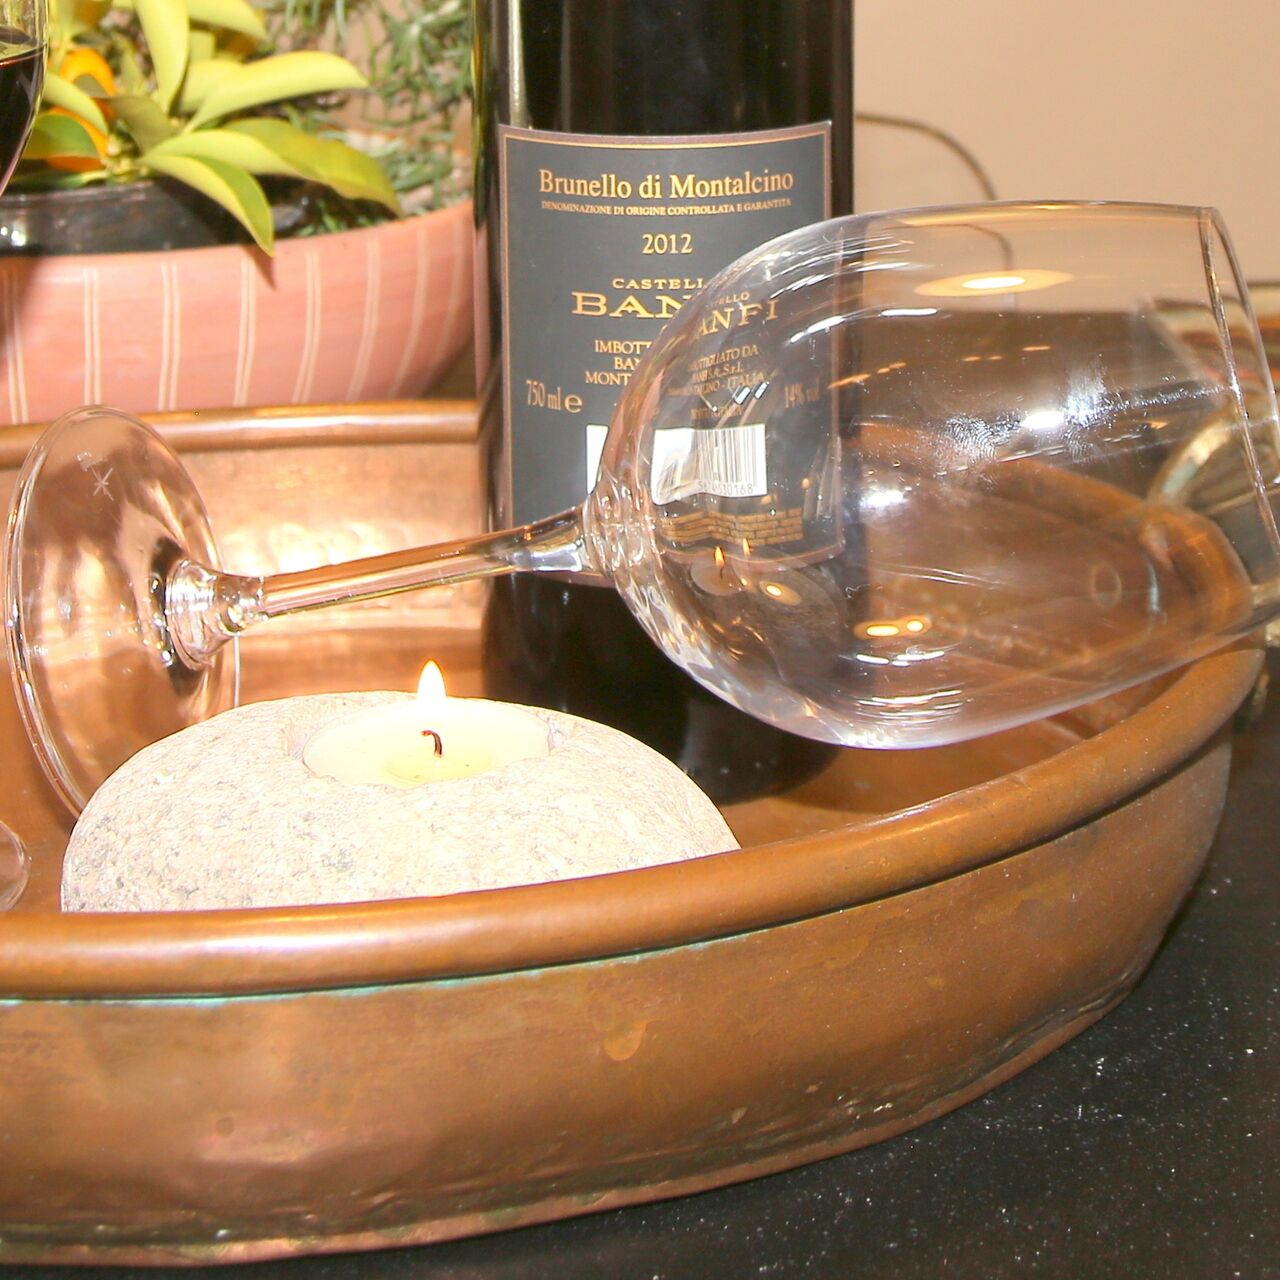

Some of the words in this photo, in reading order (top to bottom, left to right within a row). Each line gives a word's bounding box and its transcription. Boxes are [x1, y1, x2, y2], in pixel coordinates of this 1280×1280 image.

[539, 169, 632, 199] Brunello
[639, 175, 661, 199] di
[670, 170, 794, 199] Montalcino
[541, 200, 612, 215] DENOMINAZIONE
[613, 206, 624, 215] DI
[625, 206, 666, 216] ORIGINE
[667, 204, 735, 216] CONTROLLATA
[737, 204, 743, 212] E
[744, 198, 792, 212] GARANTITA
[642, 233, 693, 254] 2012
[526, 379, 546, 407] 750
[547, 386, 561, 410] ml
